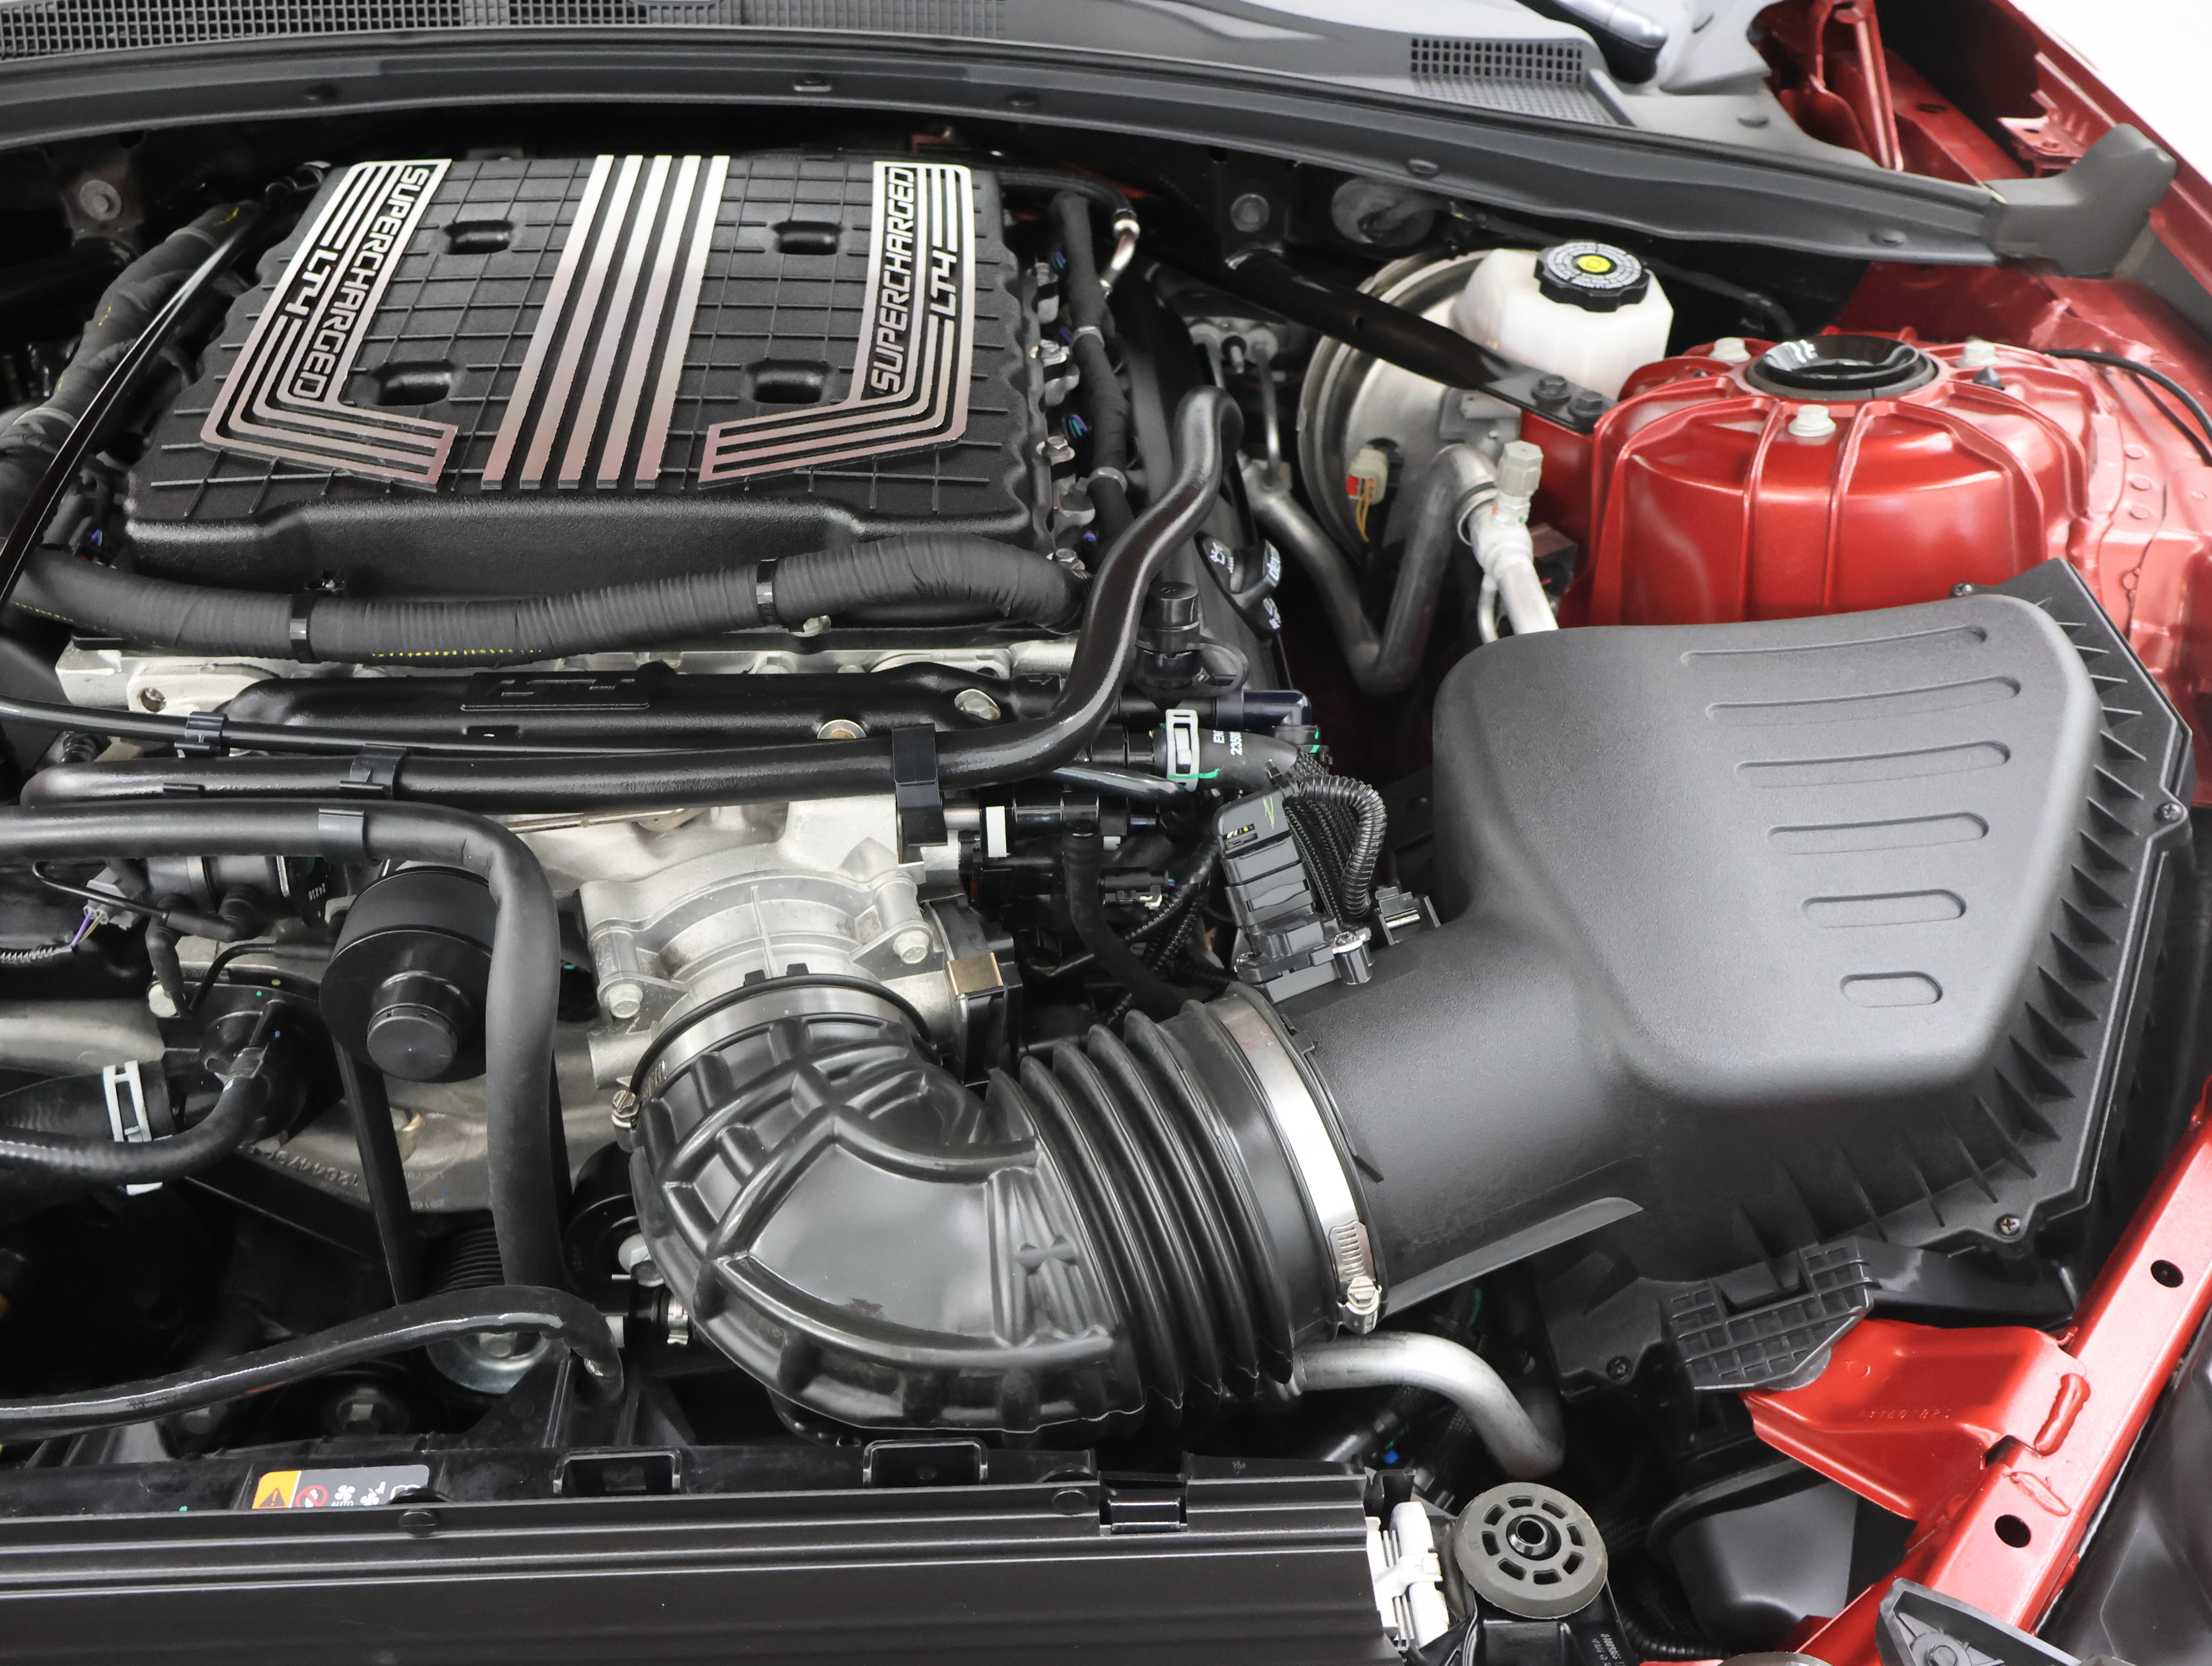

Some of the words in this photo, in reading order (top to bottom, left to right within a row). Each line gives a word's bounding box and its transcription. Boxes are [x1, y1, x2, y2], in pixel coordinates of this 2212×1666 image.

[285, 249, 337, 317] LT4
[292, 167, 430, 398] SUPERCHARGED
[871, 168, 915, 393] SUPERCHARGED
[931, 250, 957, 316] LT4
